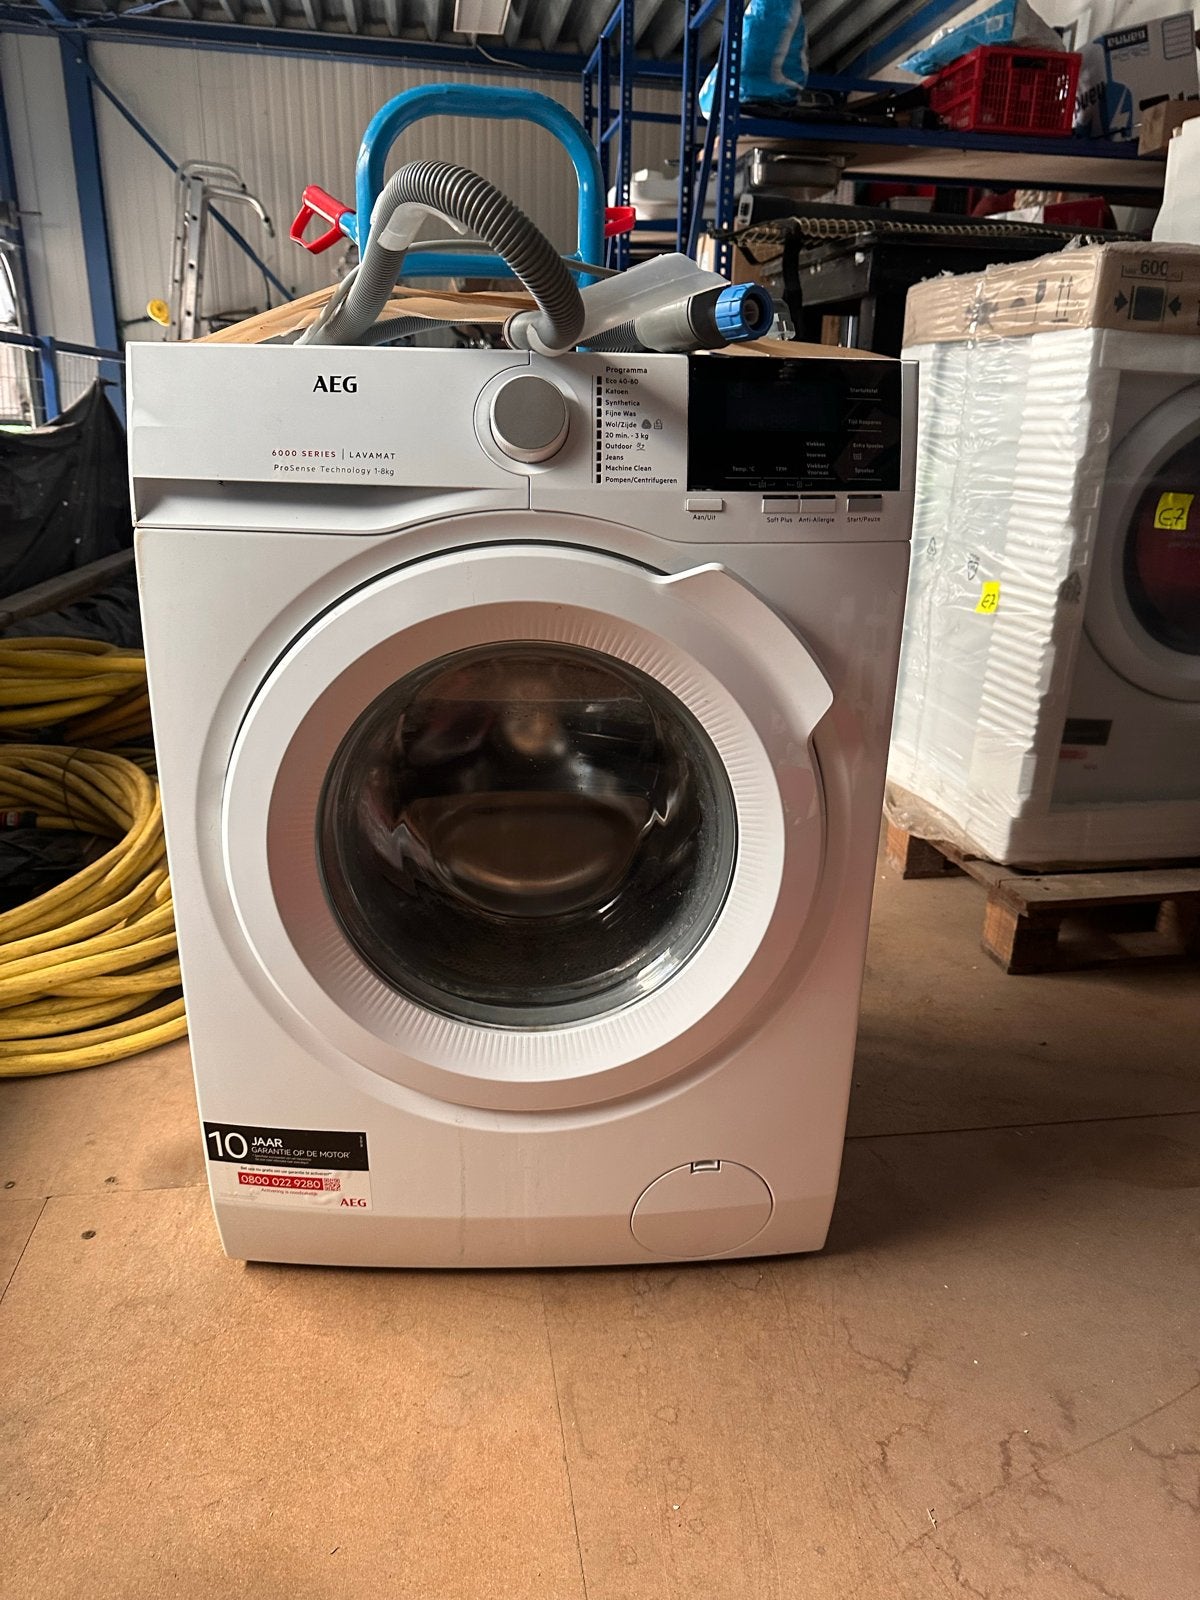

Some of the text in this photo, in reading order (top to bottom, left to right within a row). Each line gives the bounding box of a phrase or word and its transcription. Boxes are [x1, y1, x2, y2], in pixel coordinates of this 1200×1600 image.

[605, 366, 648, 375] Programma
[312, 375, 358, 393] AEG
[605, 410, 622, 418] Fijne
[605, 421, 638, 429] Wol/Zijde
[271, 449, 396, 460] 6000 SERIES LAVAMAT
[273, 464, 395, 477] ProSense Technology 1-8kg
[605, 476, 678, 485] Pompen/Centrifugeren
[208, 1131, 248, 1159] 10
[251, 1136, 283, 1148] JAAR
[251, 1146, 291, 1156] GARANTIE
[292, 1149, 305, 1157] OP
[240, 1174, 321, 1189] 0800 022 9280
[340, 1198, 367, 1207] AEG
